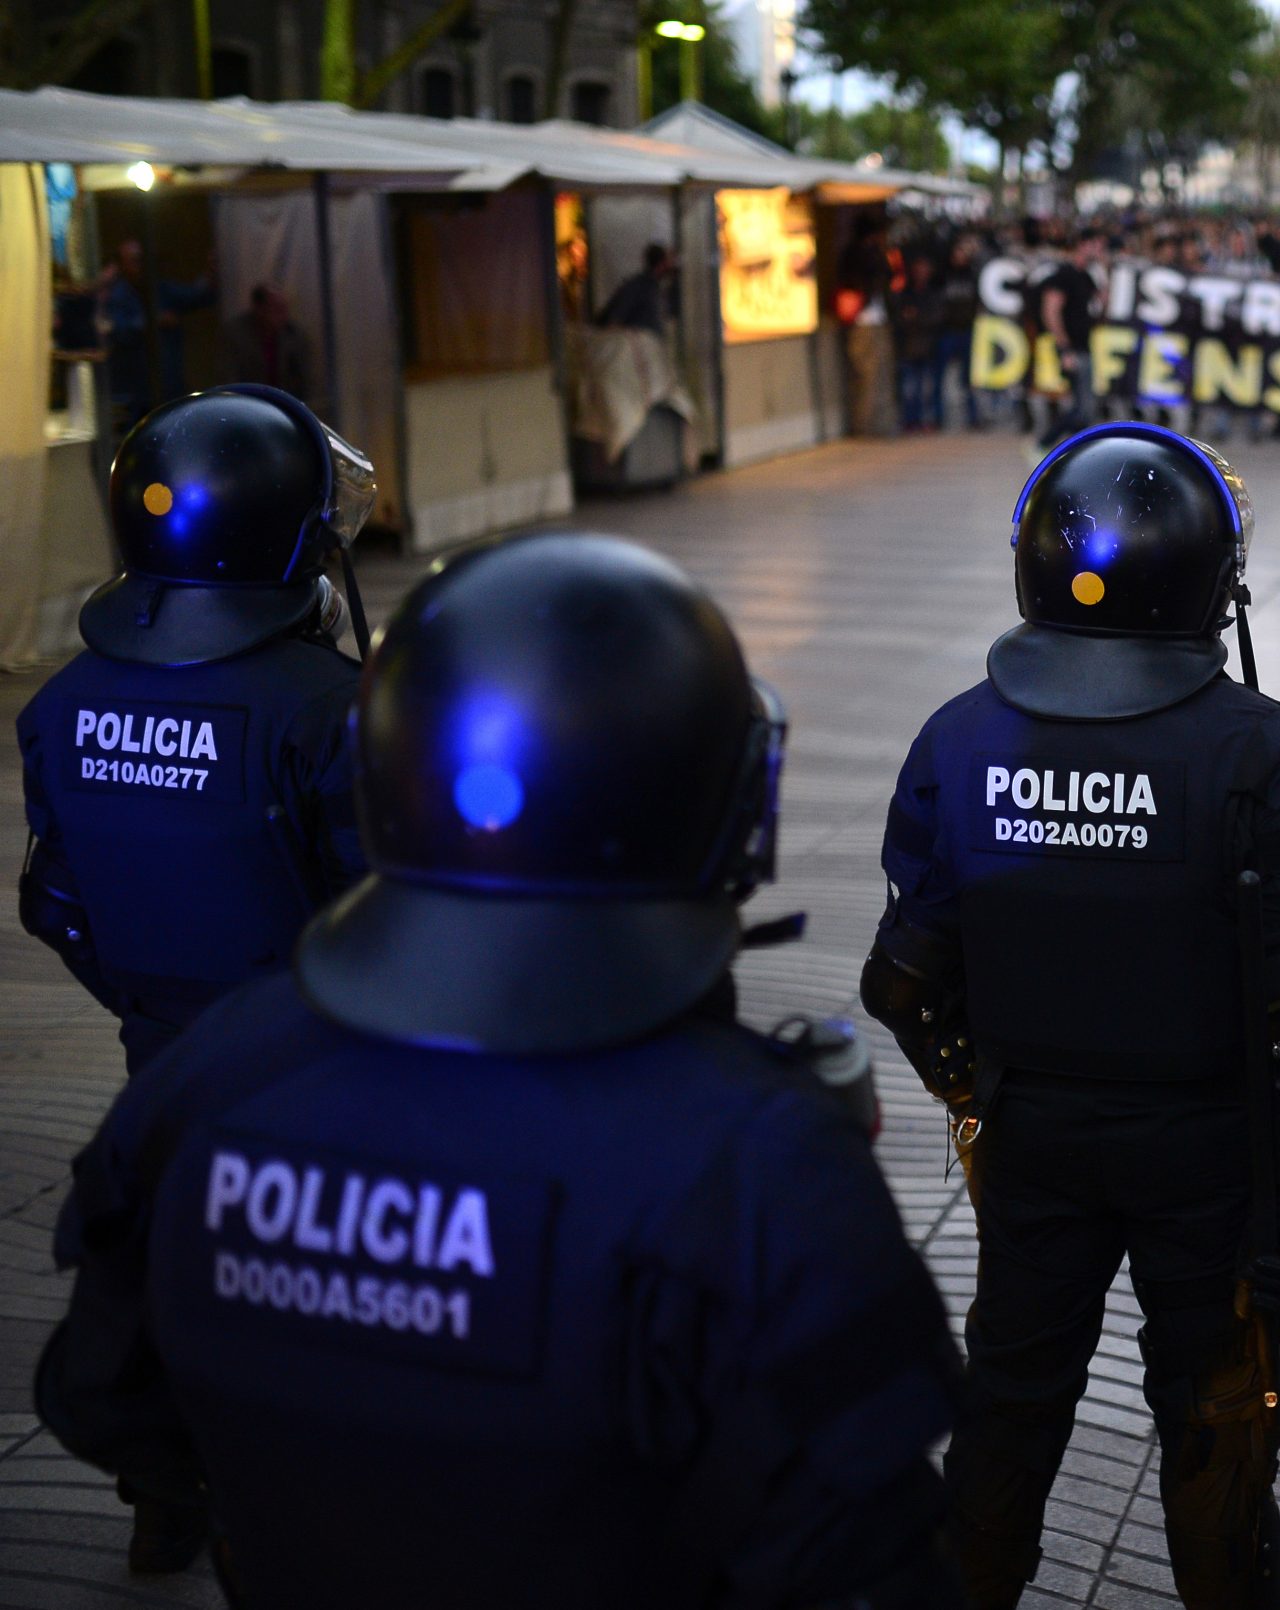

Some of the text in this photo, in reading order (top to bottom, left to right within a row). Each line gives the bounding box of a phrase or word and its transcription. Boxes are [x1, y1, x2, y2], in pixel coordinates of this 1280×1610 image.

[75, 709, 218, 761] POLICIA
[81, 757, 209, 791] D210A0277
[986, 766, 1158, 815] POLICIA
[995, 817, 1148, 849] D202A0079
[205, 1150, 496, 1279] POLICIA
[214, 1249, 471, 1340] D000A5601
